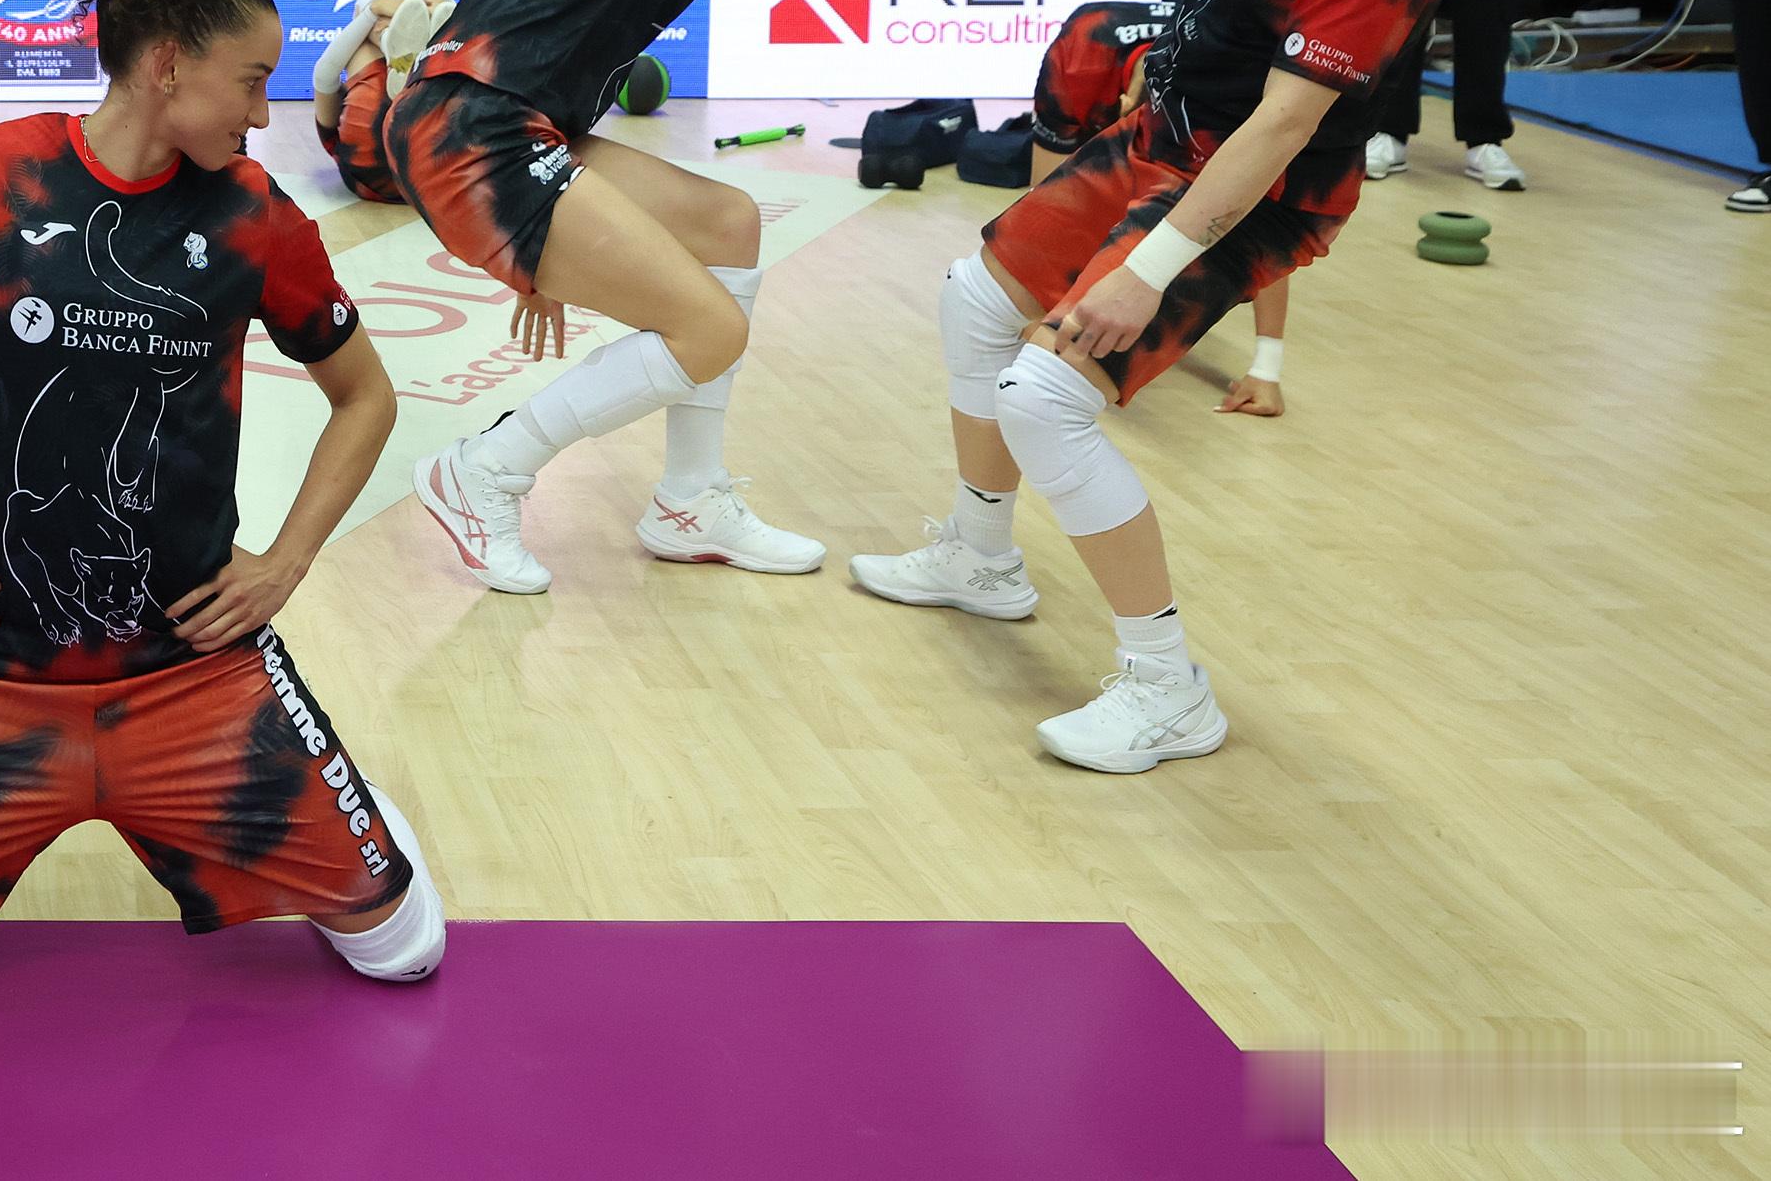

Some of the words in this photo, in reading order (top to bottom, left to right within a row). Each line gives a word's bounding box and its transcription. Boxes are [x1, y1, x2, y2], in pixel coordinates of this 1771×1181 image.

[1302, 50, 1342, 74] BANCA
[1342, 65, 1371, 84] FININT
[1308, 39, 1354, 64] GRUPPO
[62, 302, 154, 330] GRUPPO
[61, 326, 141, 353] BANCA
[146, 334, 212, 357] FININT
[319, 751, 371, 838] Due
[358, 839, 391, 877] srl
